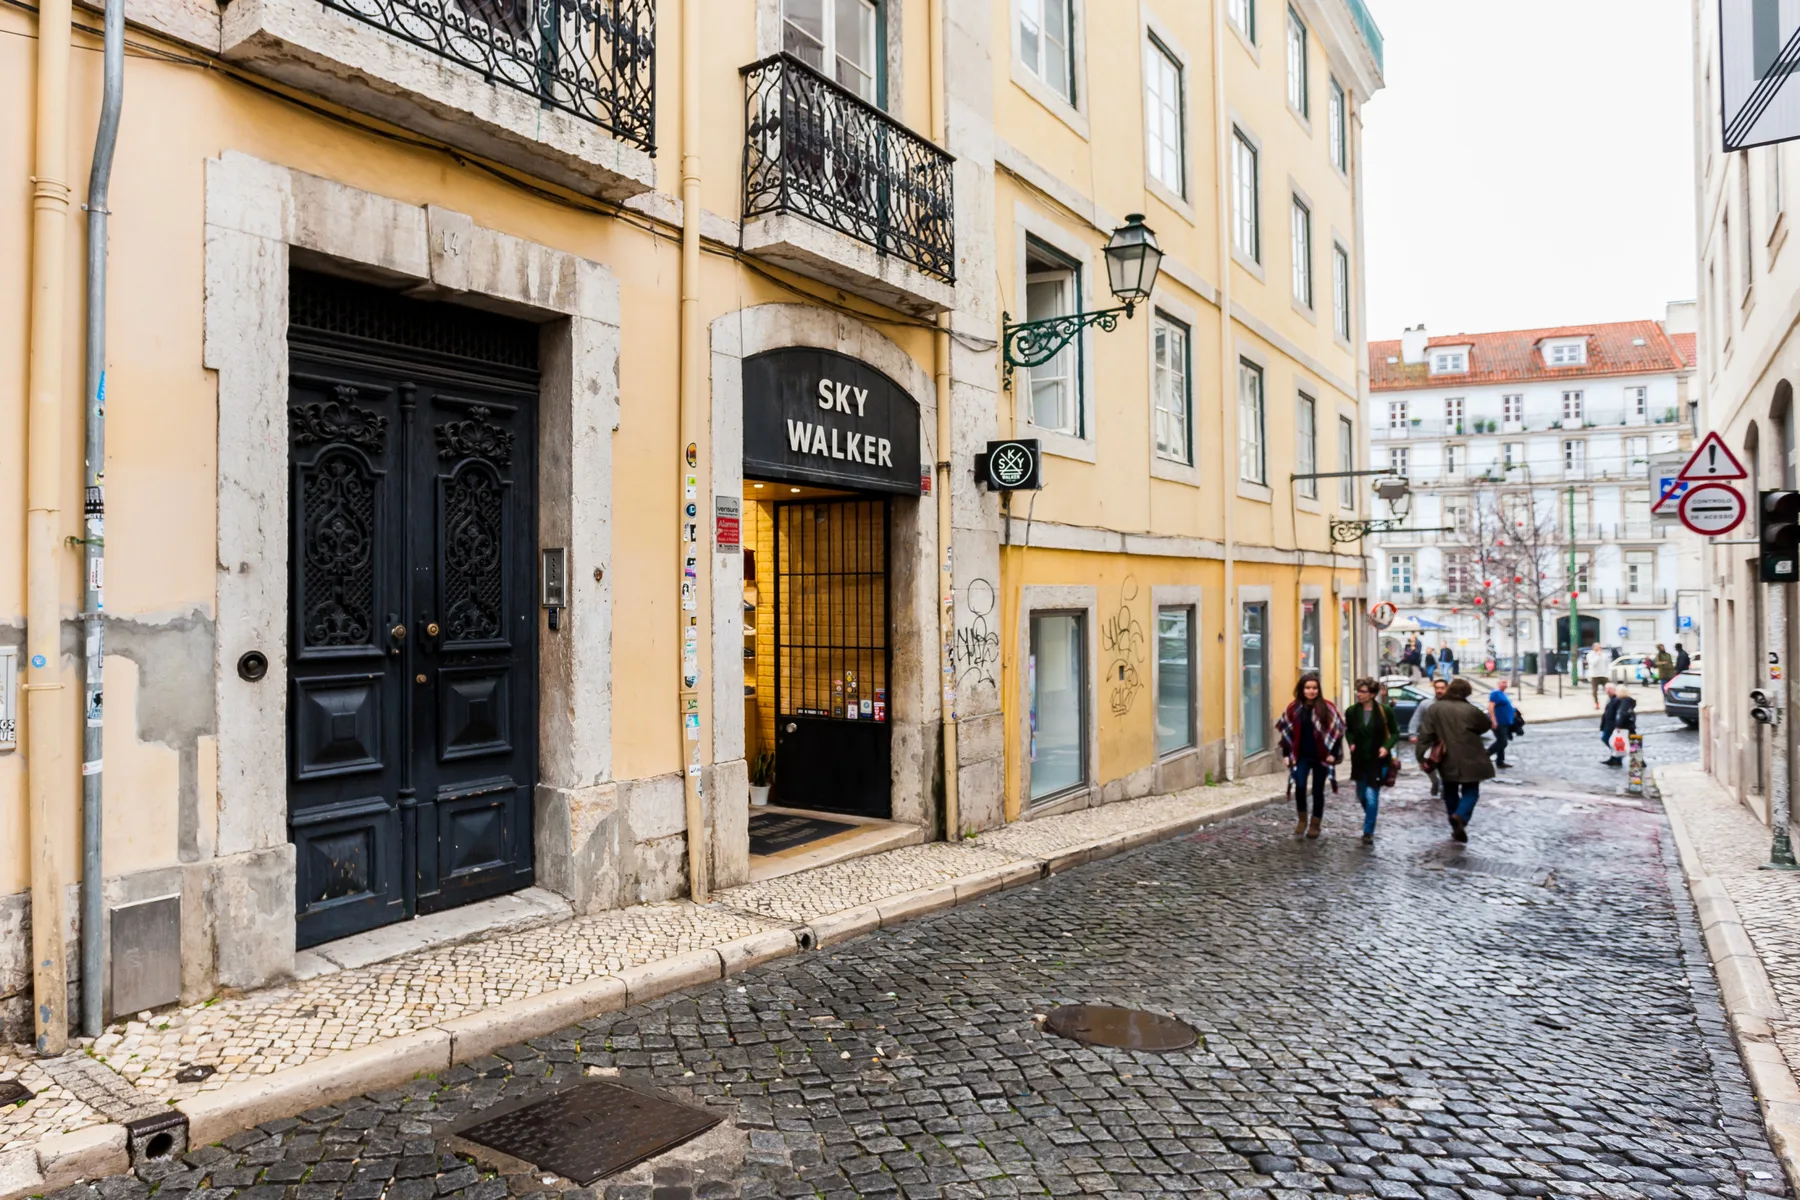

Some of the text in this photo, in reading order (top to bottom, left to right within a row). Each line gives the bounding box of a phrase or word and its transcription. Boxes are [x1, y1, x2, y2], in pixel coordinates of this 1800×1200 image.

[818, 378, 869, 417] SKY
[787, 418, 893, 468] WALKER
[998, 449, 1025, 469] SKY
[1680, 617, 1689, 627] P
